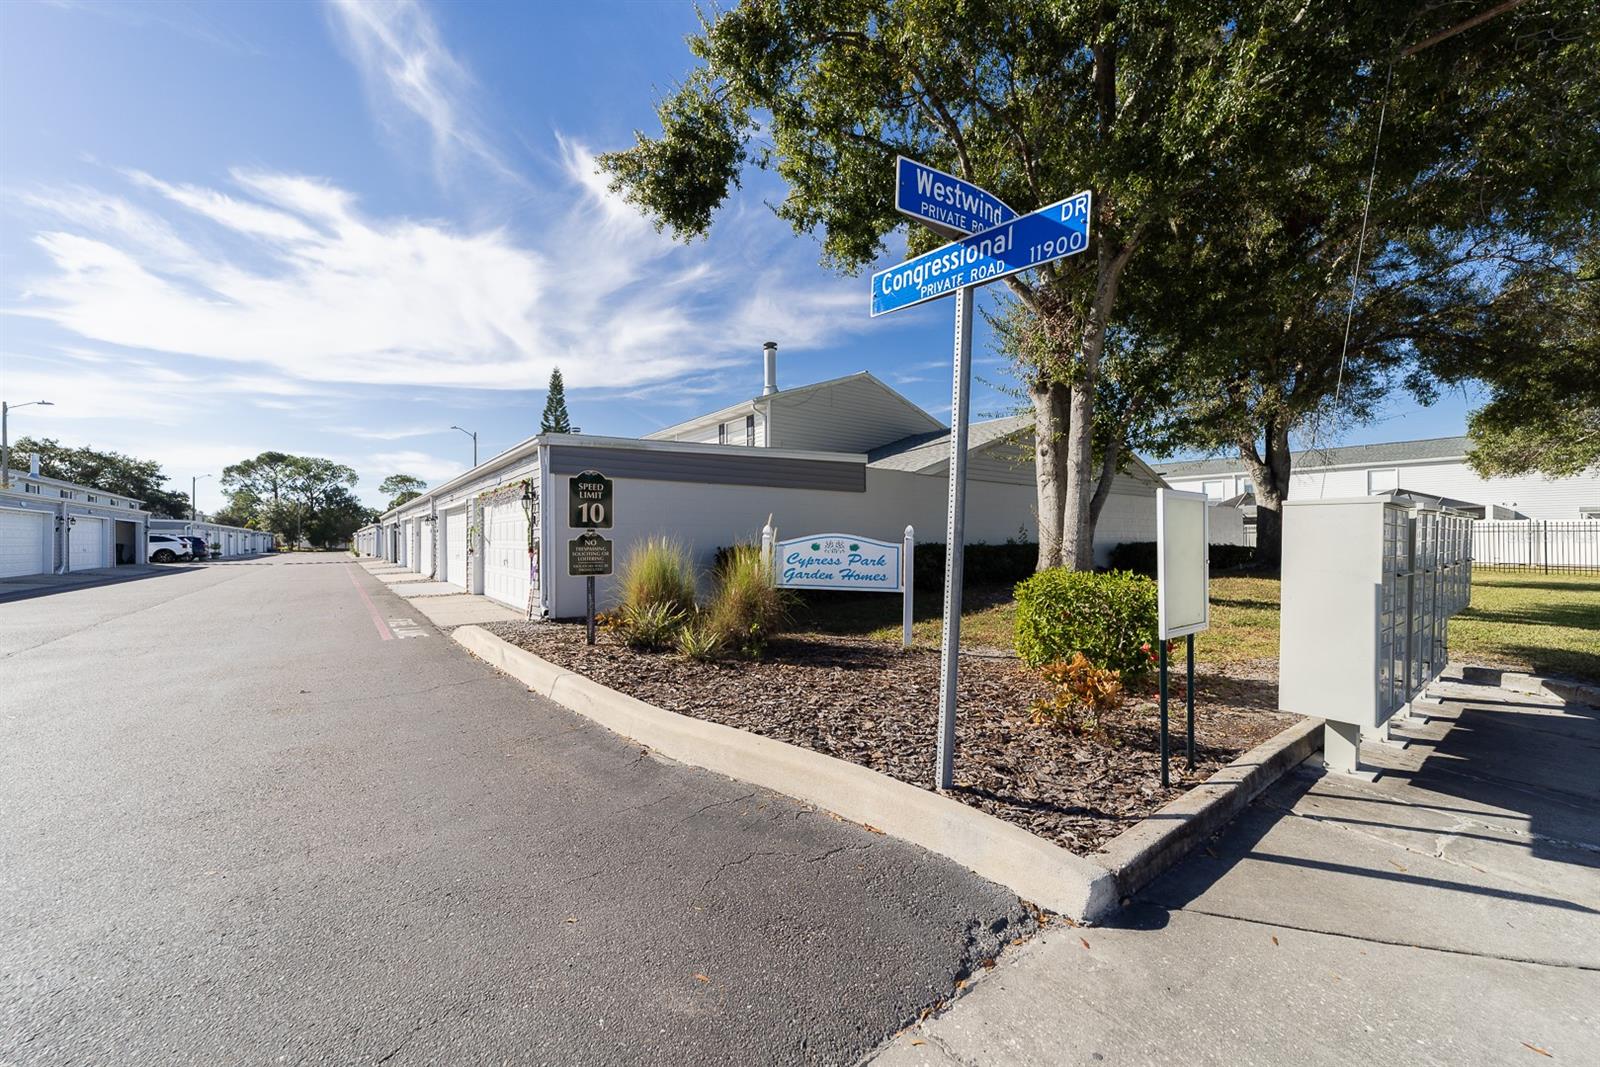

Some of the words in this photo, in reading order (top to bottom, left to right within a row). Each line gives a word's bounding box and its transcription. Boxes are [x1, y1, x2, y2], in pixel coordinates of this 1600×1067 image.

[916, 168, 1002, 225] Westwind
[921, 202, 966, 229] PRIVATE
[882, 225, 1014, 295] Congressional
[1061, 196, 1087, 222] DR
[920, 275, 965, 299] PRIVATE
[970, 259, 1005, 282] ROAD
[1029, 231, 1082, 263] 11900
[578, 482, 604, 491] SPEED
[579, 491, 603, 499] LIMIT
[578, 502, 605, 523] 10
[786, 552, 841, 568] Cypress
[847, 553, 886, 567] Park
[783, 567, 833, 583] Garden
[839, 568, 888, 581] Homes
